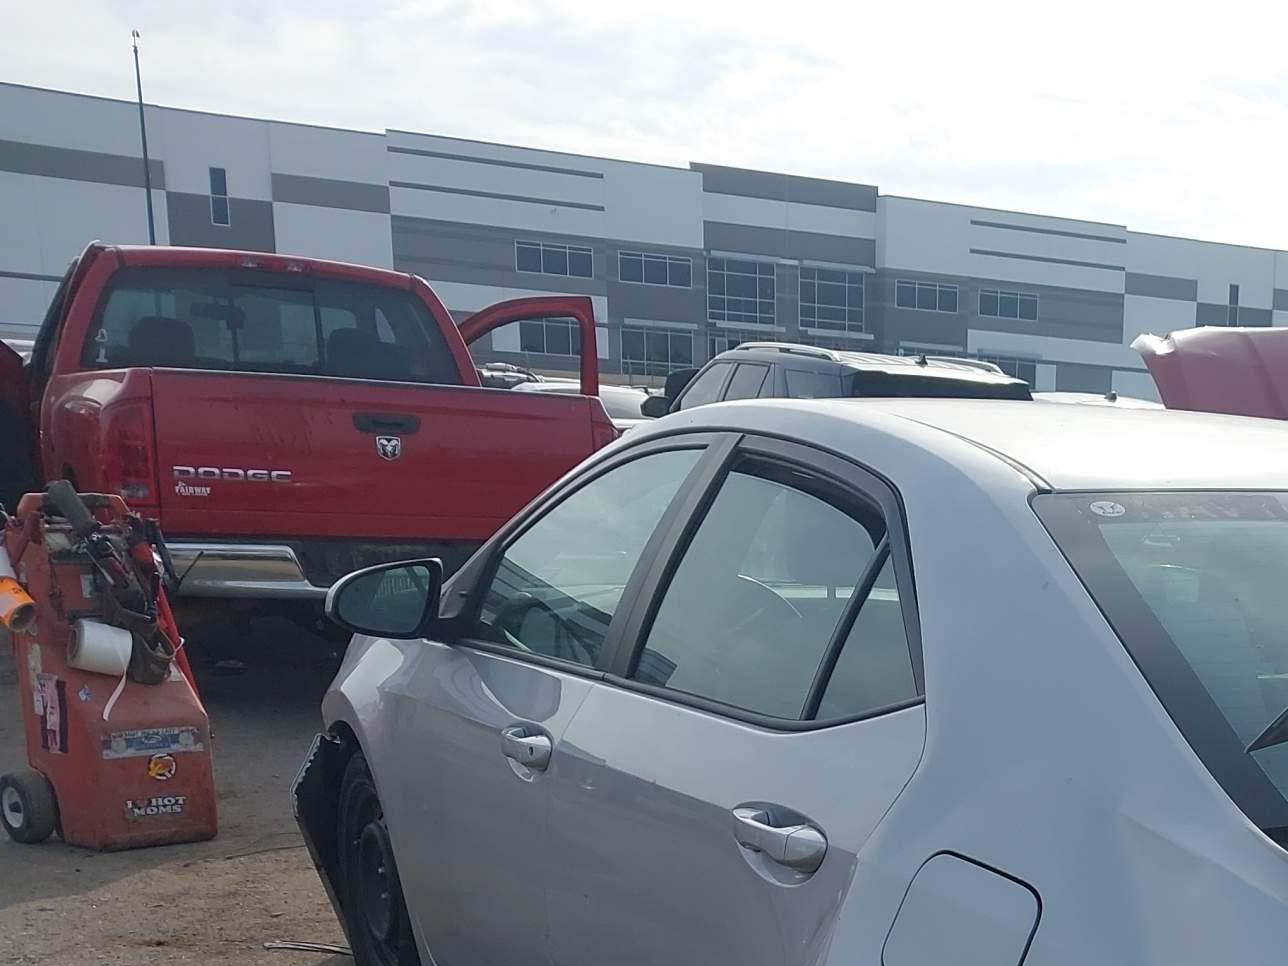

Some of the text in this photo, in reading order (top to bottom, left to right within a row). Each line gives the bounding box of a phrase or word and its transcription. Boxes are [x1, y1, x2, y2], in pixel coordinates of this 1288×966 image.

[173, 465, 291, 481] DODGE
[151, 796, 186, 807] HOT
[133, 804, 182, 816] MOMS
